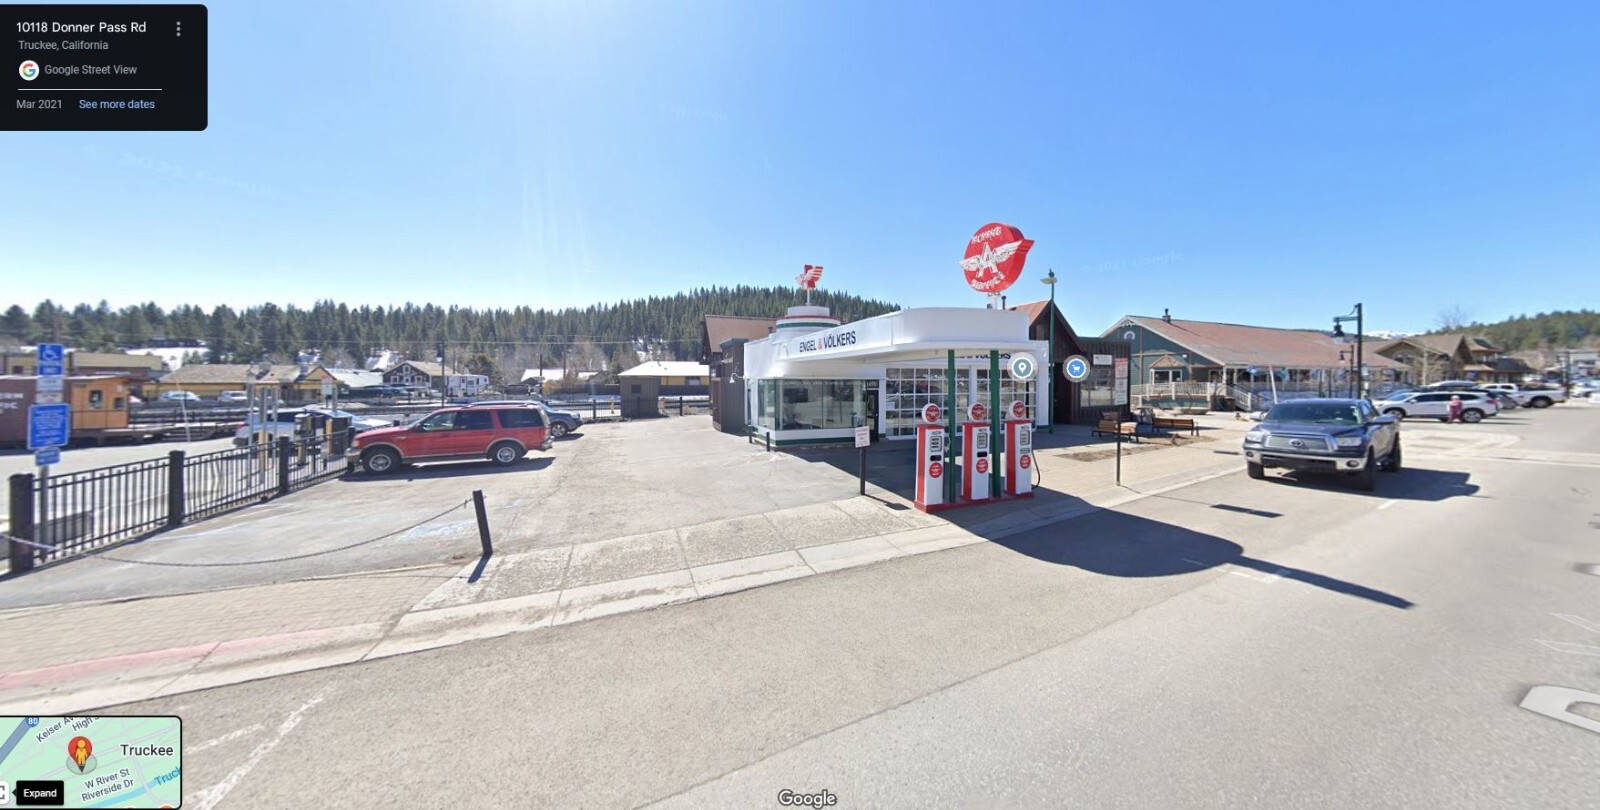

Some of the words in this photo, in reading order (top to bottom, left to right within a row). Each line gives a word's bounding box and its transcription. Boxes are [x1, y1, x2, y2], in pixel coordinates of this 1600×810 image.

[799, 339, 817, 353] ENGEL
[817, 338, 823, 350] &
[823, 330, 857, 349] VÖLKERS
